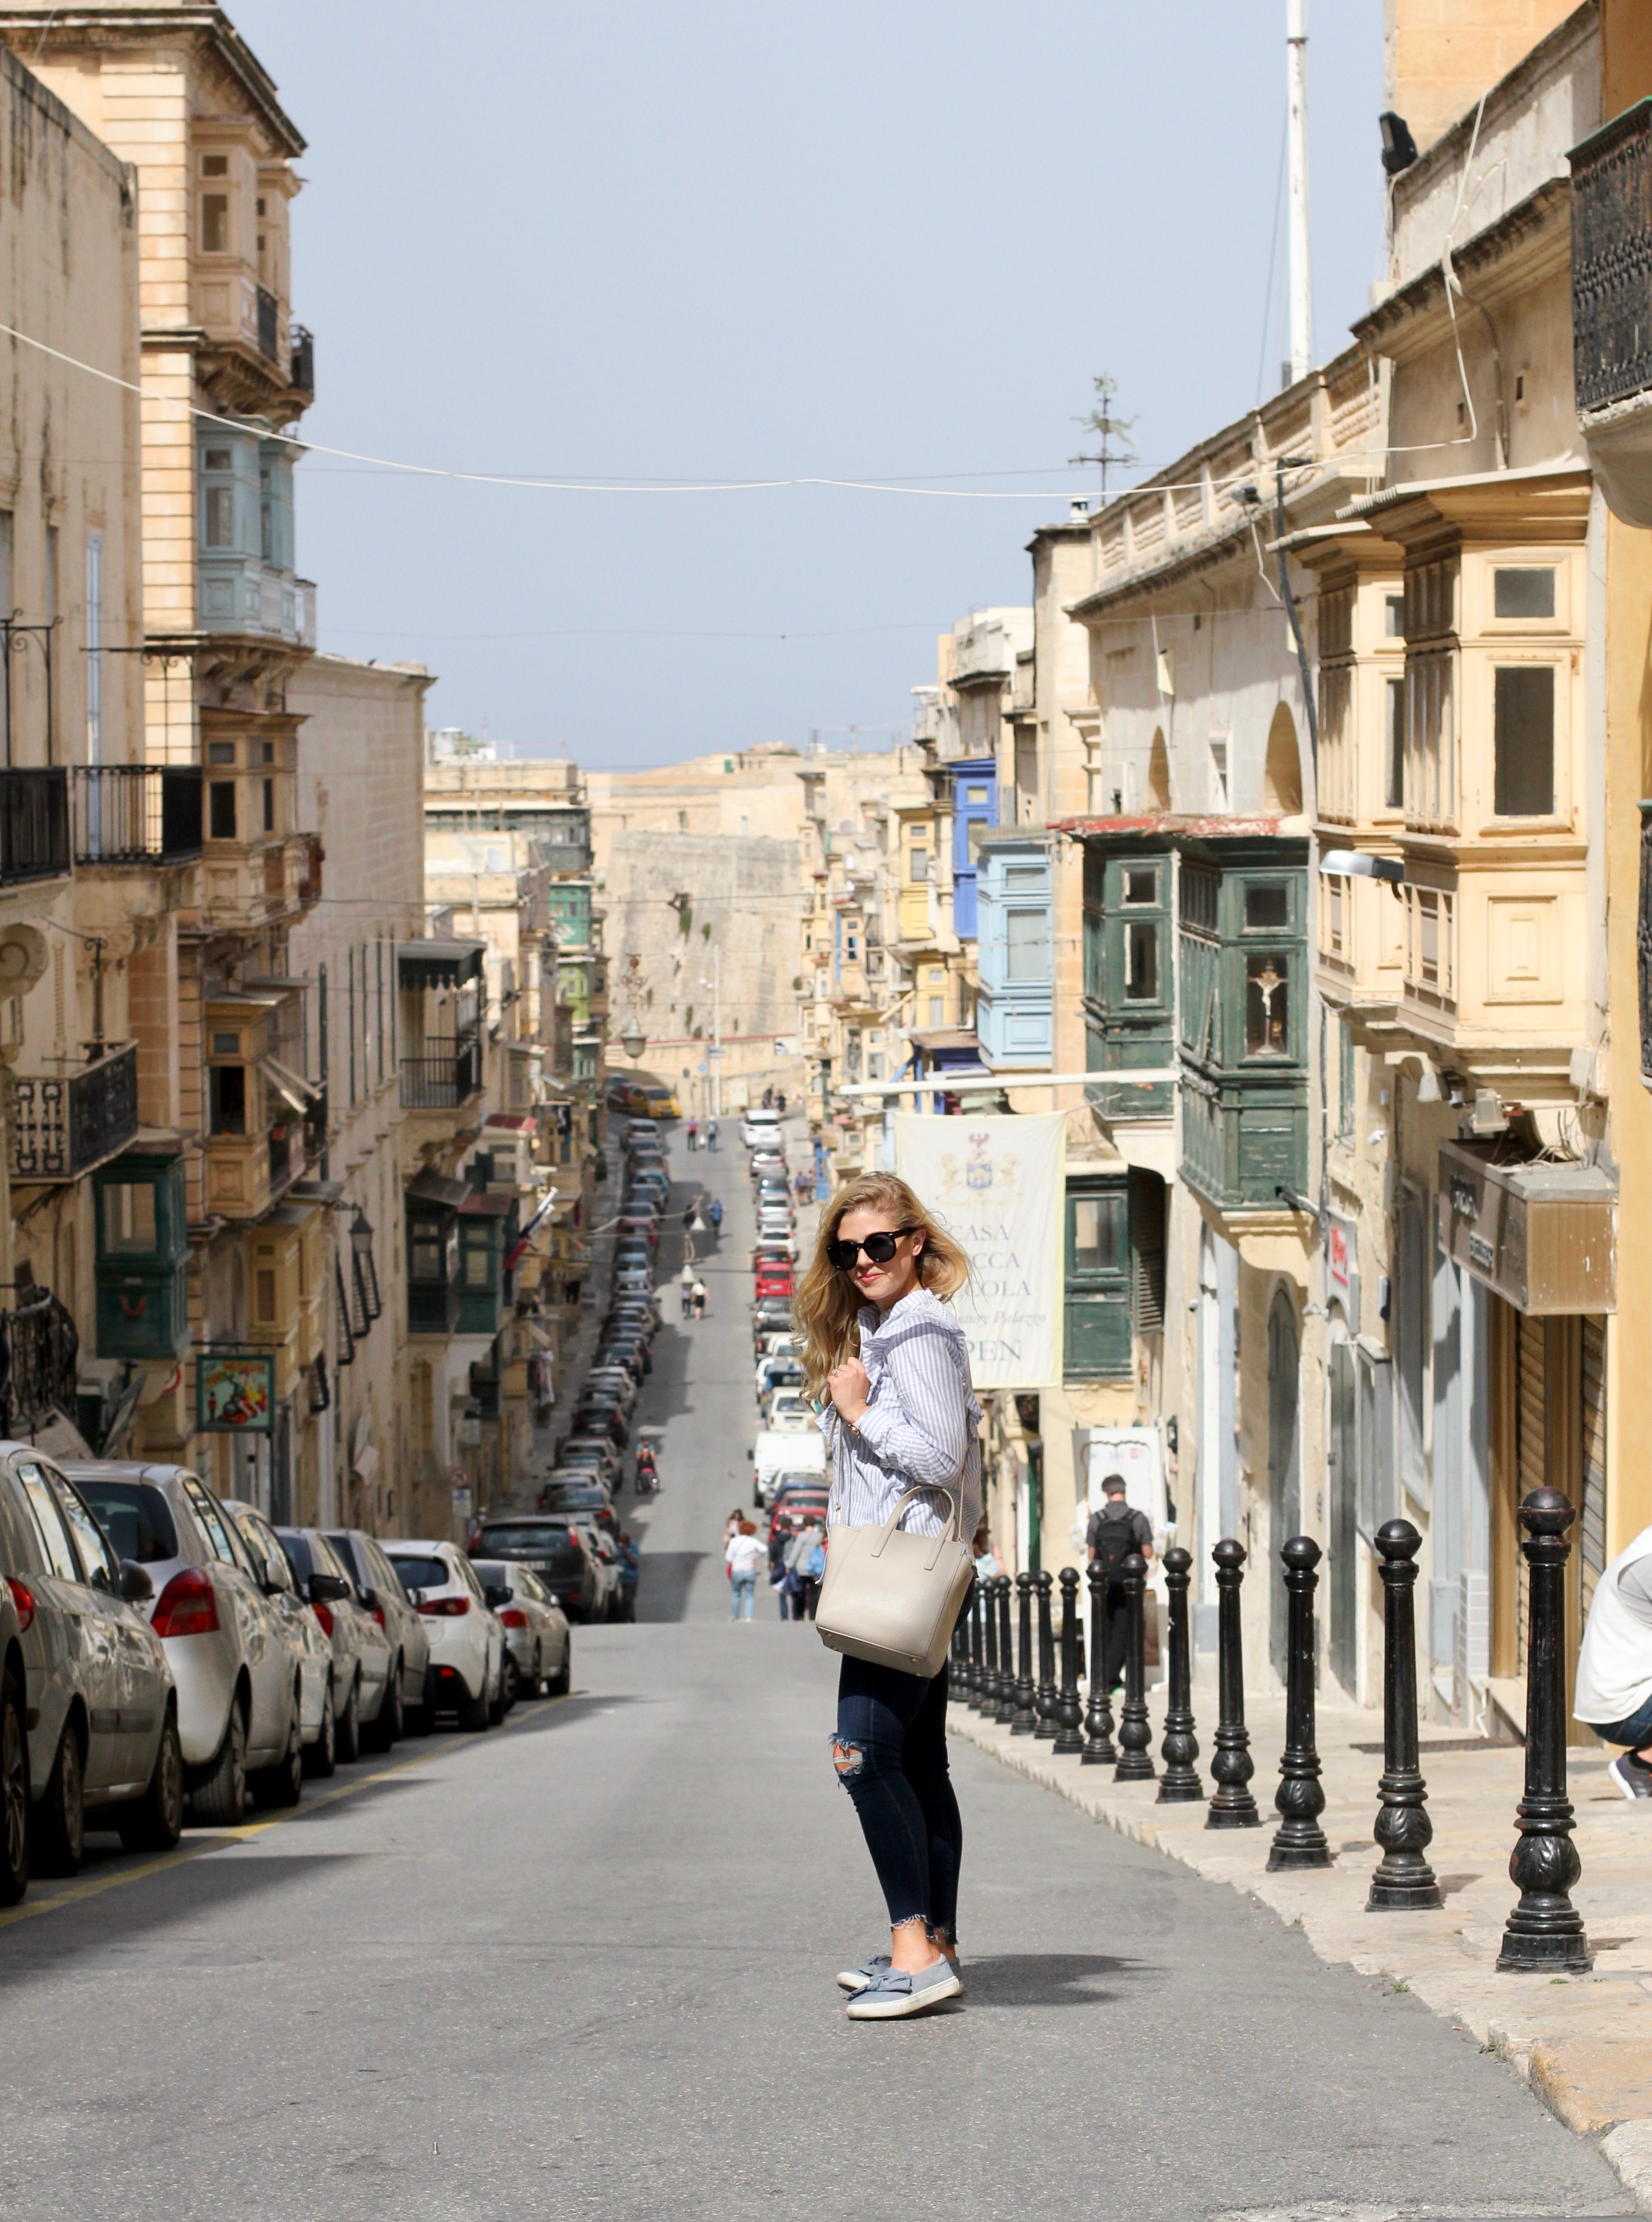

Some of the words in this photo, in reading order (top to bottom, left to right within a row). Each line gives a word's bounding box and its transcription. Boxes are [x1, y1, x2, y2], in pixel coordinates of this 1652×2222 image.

[948, 1224, 1009, 1241] CASA
[972, 1252, 1020, 1269] CCA
[994, 1310, 1047, 1327] Palazzo
